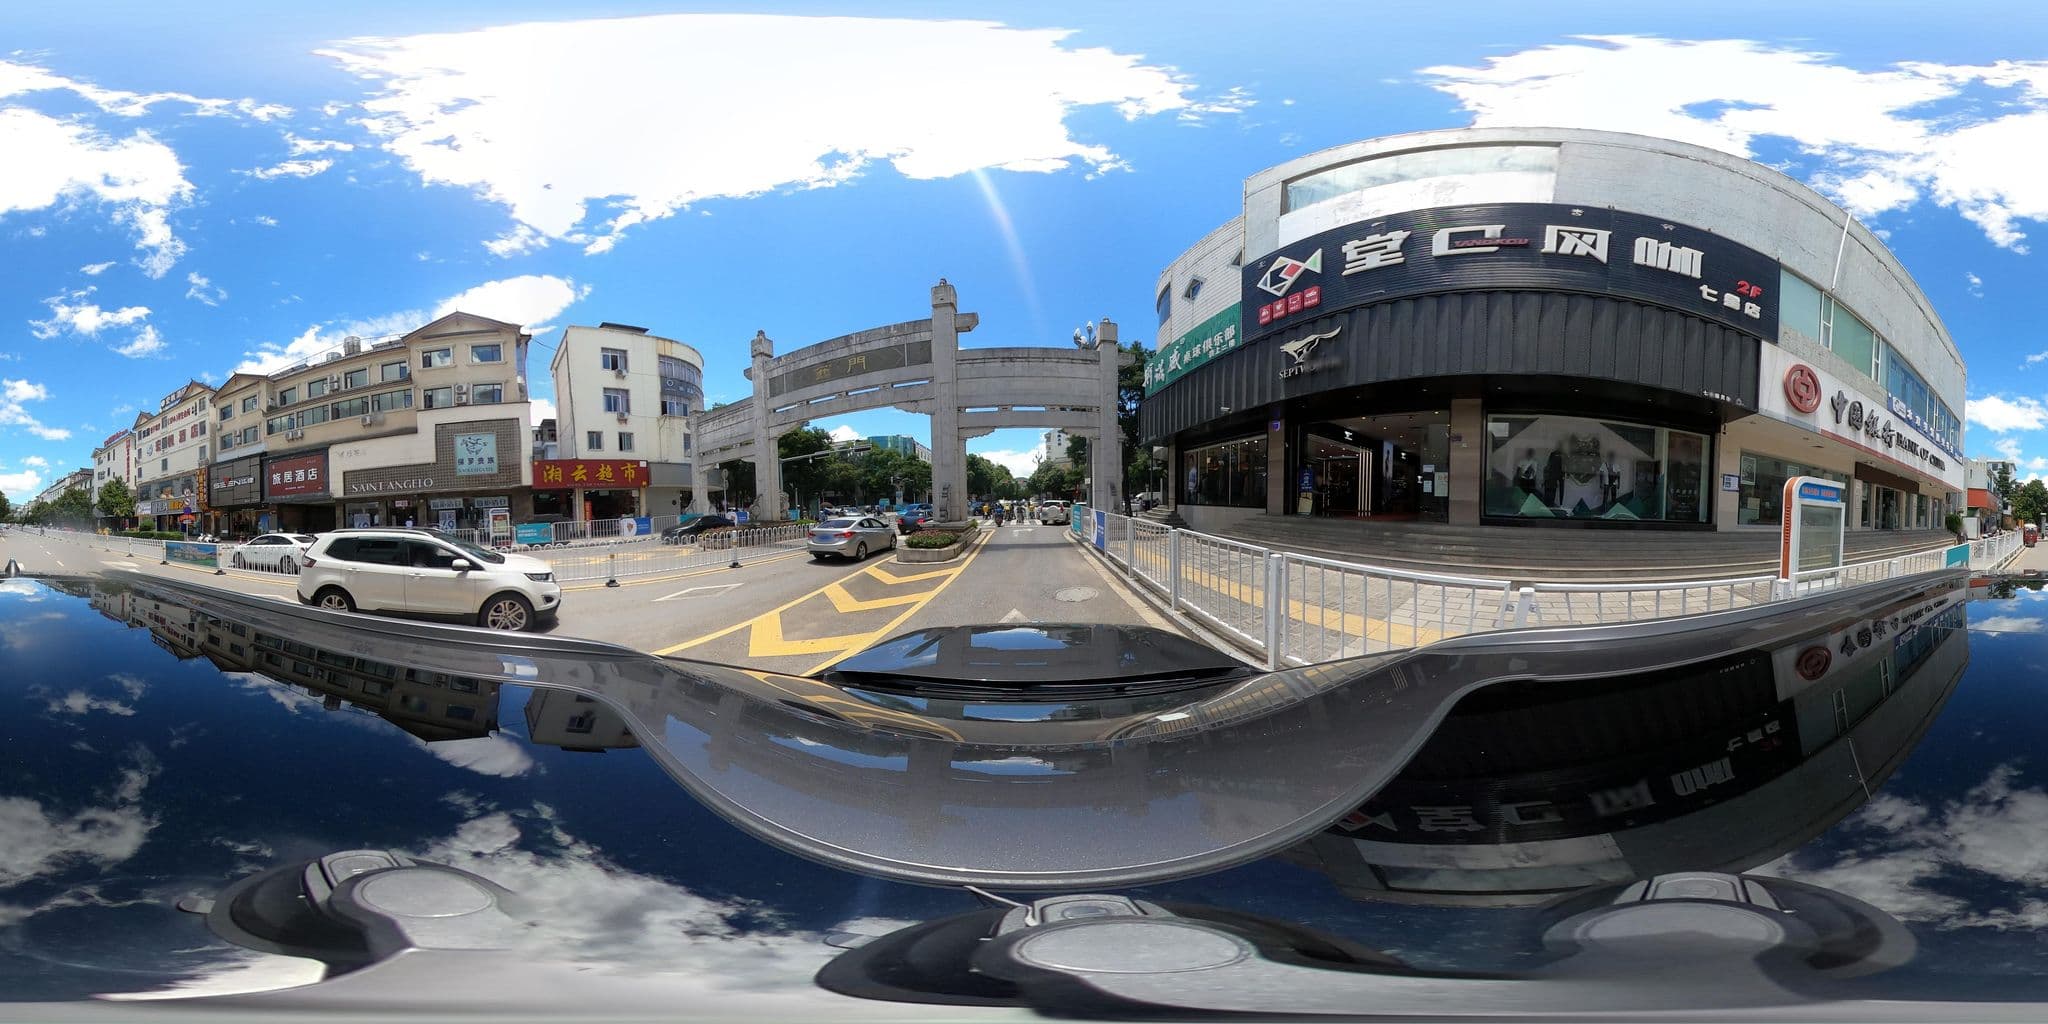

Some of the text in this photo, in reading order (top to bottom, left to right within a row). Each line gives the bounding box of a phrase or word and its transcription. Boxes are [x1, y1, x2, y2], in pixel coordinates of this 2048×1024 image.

[1736, 280, 1762, 298] 2F
[1831, 390, 1895, 448] 中国银行
[1896, 432, 1920, 457] BANK
[1920, 447, 1930, 461] OF
[543, 463, 638, 482] 湘云超市
[352, 478, 433, 492] SAINT ANGELO
